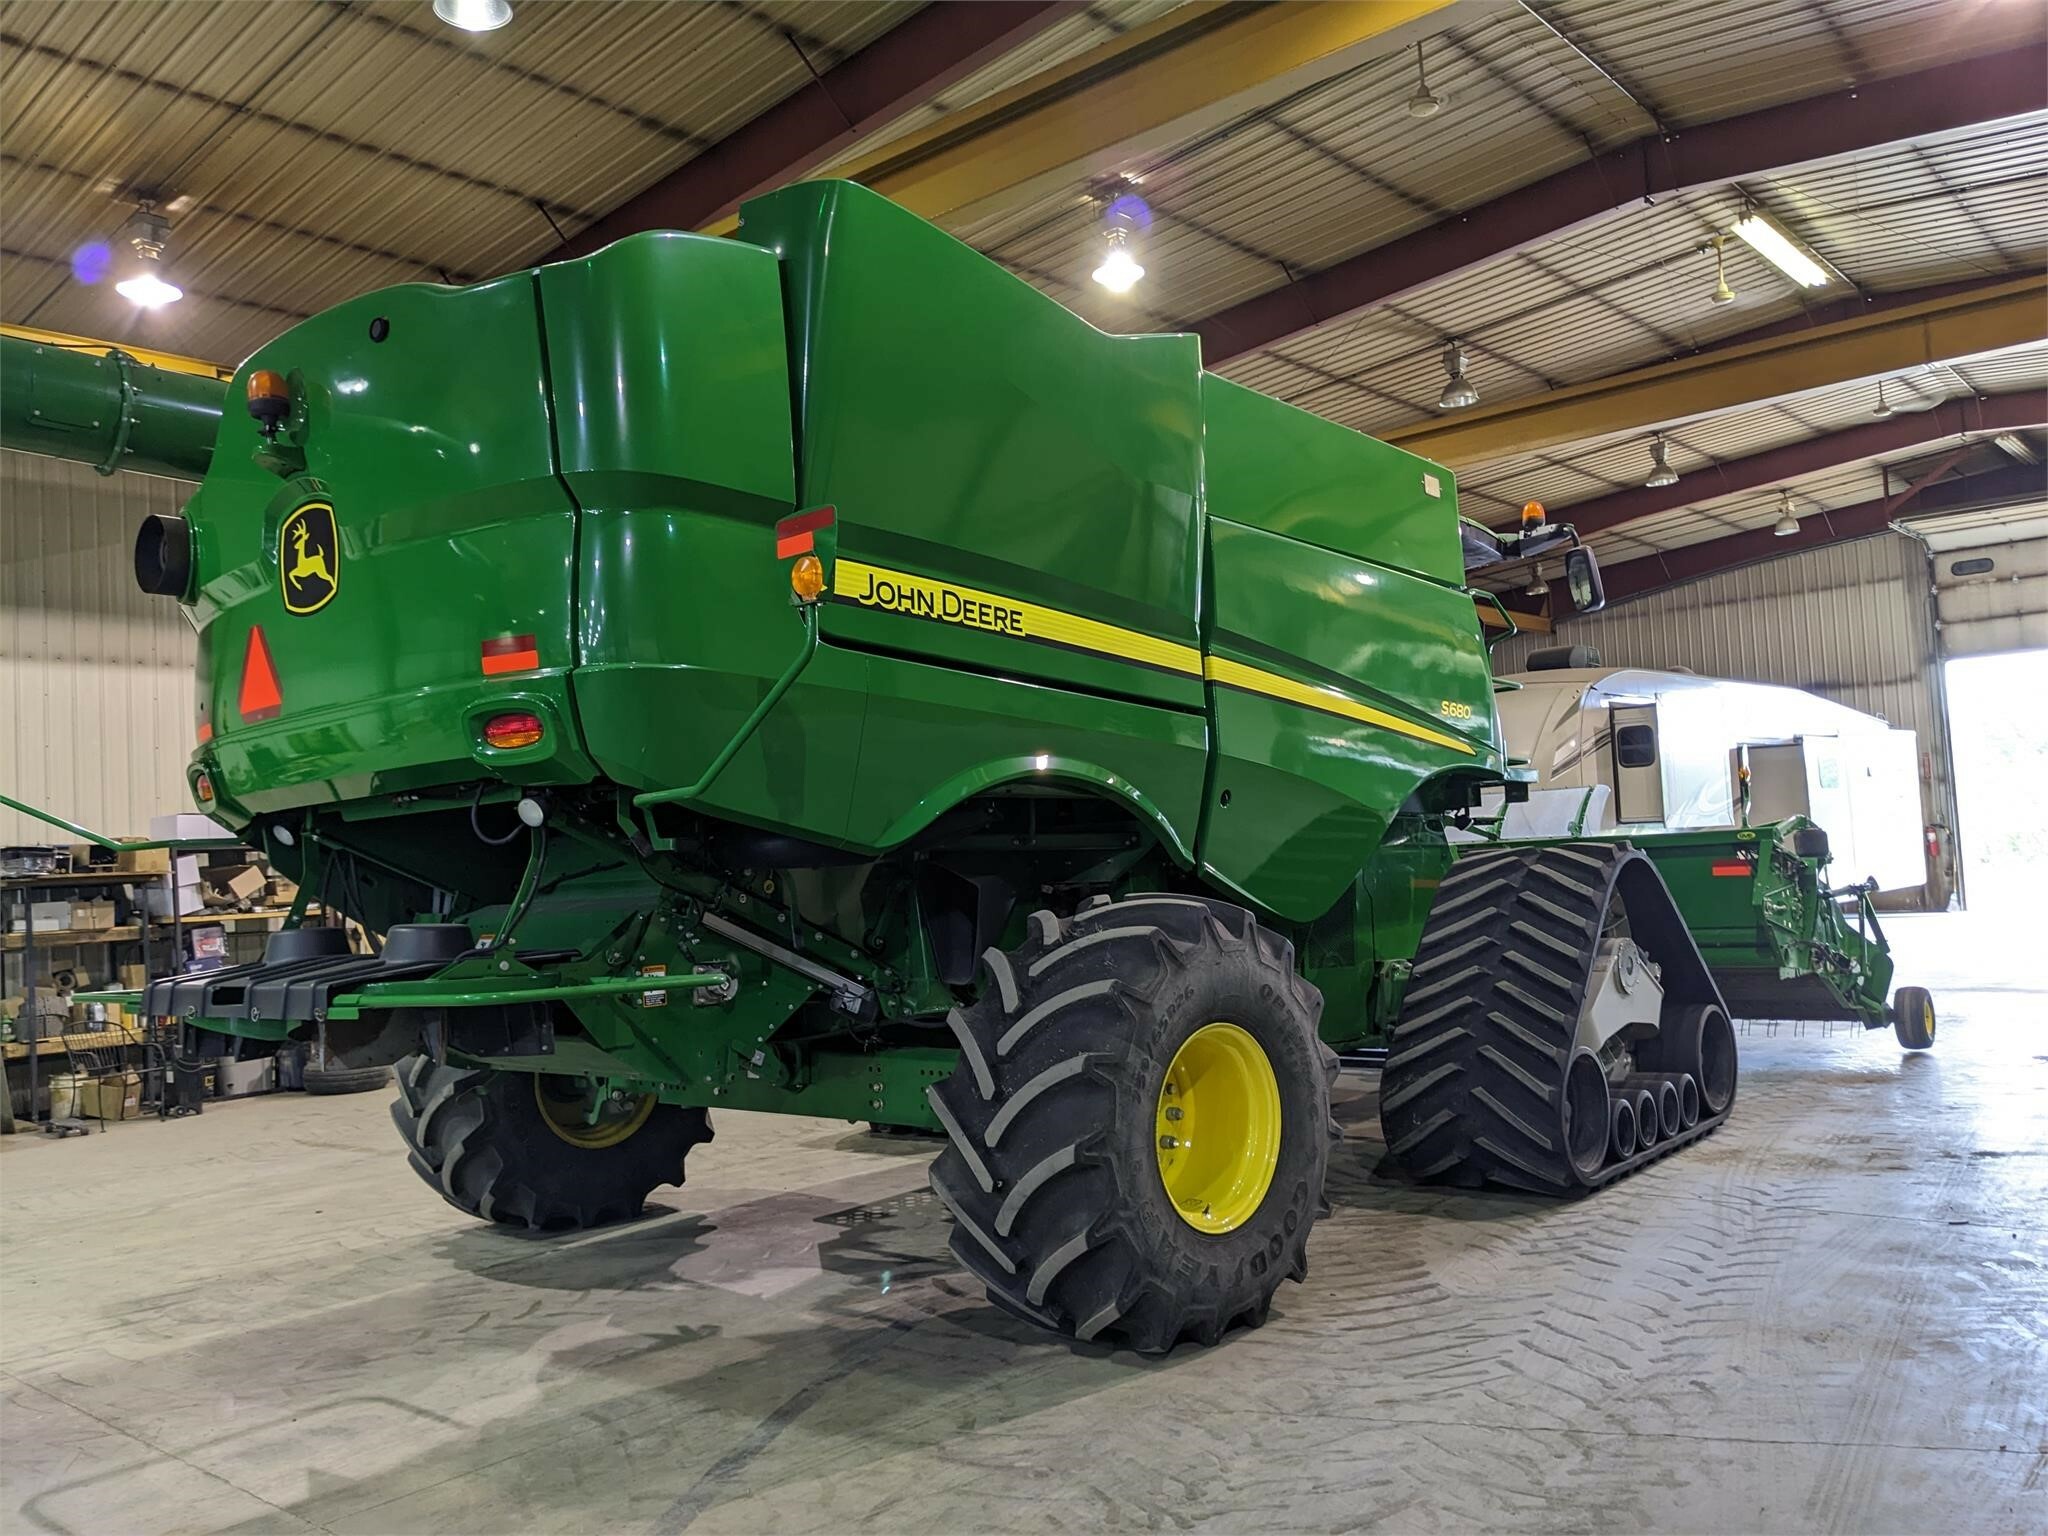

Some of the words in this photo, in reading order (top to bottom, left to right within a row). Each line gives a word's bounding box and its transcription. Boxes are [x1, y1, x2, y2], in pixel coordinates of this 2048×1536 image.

[859, 573, 935, 614] JOHN
[942, 589, 1023, 632] DEERE
[1441, 700, 1471, 719] S680
